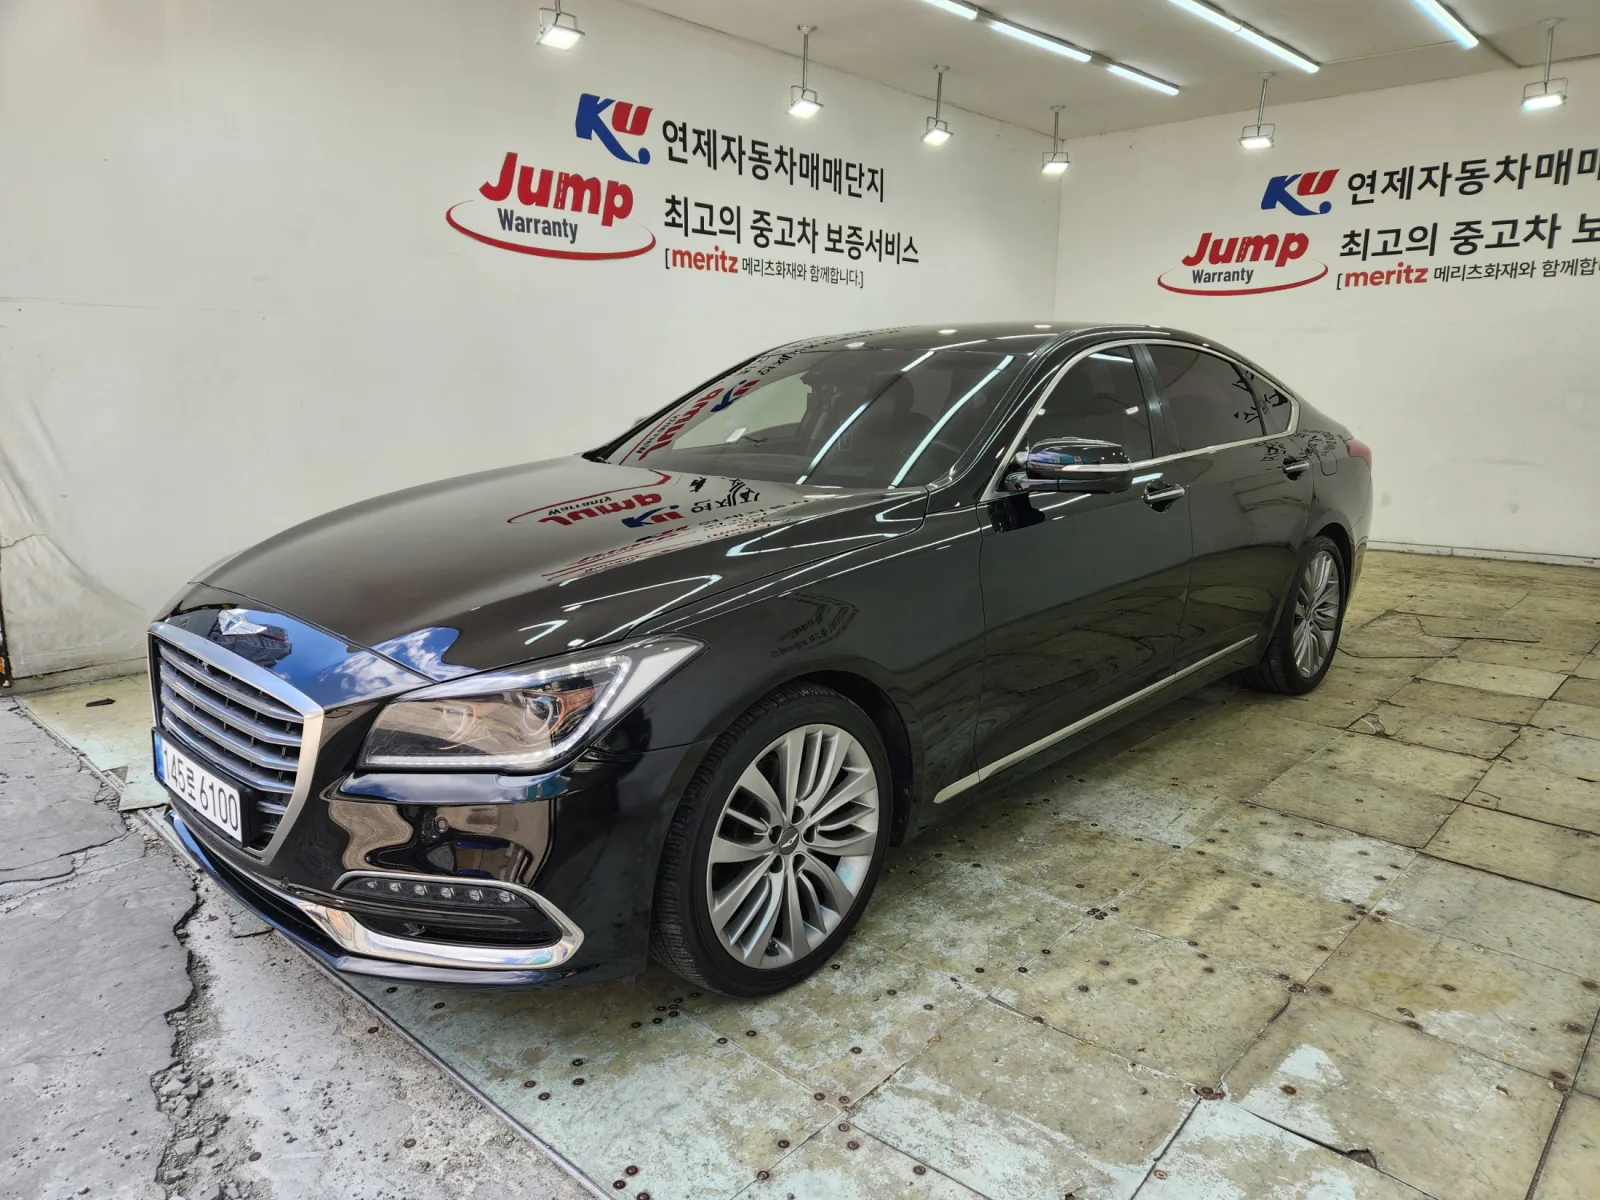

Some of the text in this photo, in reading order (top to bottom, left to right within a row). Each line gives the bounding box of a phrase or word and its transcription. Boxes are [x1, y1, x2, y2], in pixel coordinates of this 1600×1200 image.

[662, 119, 884, 203] 연제자동차매매단지
[479, 151, 634, 227] Jump
[497, 207, 578, 244] Warranty
[664, 194, 919, 265] 최고의 중고차 보증서비스
[1339, 222, 1438, 262] 최고의
[1450, 213, 1562, 256] 중고차
[742, 256, 807, 281] 메리츠화재와
[1181, 232, 1310, 267] Jump
[1433, 260, 1536, 283] 메리츠화재와
[1542, 256, 1600, 278] 함께합
[1192, 267, 1254, 285] Warranty
[200, 775, 239, 832] 6100
